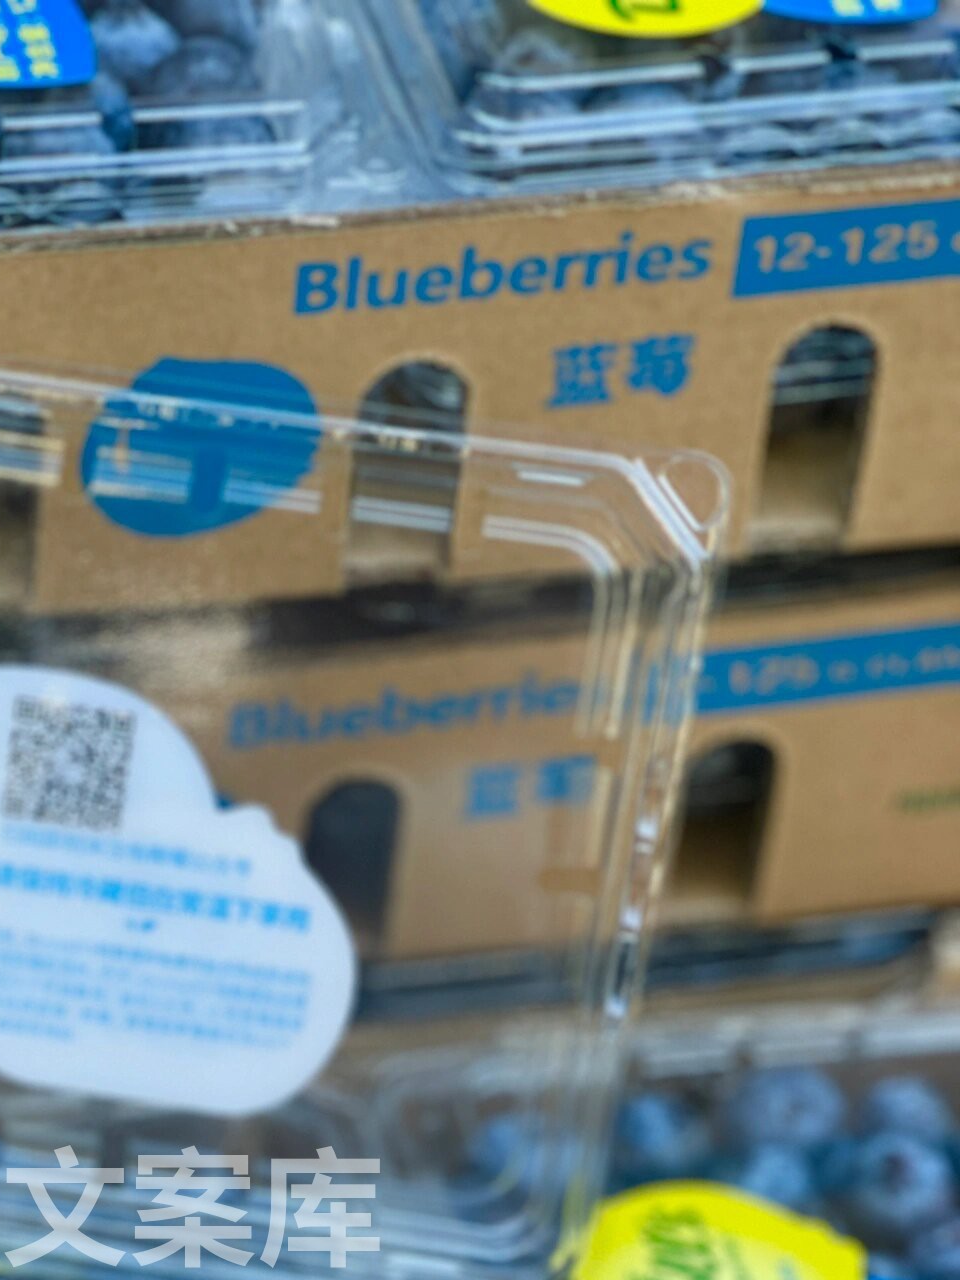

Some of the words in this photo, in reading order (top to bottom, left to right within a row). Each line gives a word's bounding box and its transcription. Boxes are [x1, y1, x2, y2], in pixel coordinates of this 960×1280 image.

[294, 231, 714, 315] Blueberries
[753, 219, 939, 274] 12-125
[548, 334, 696, 409] 蓝莓
